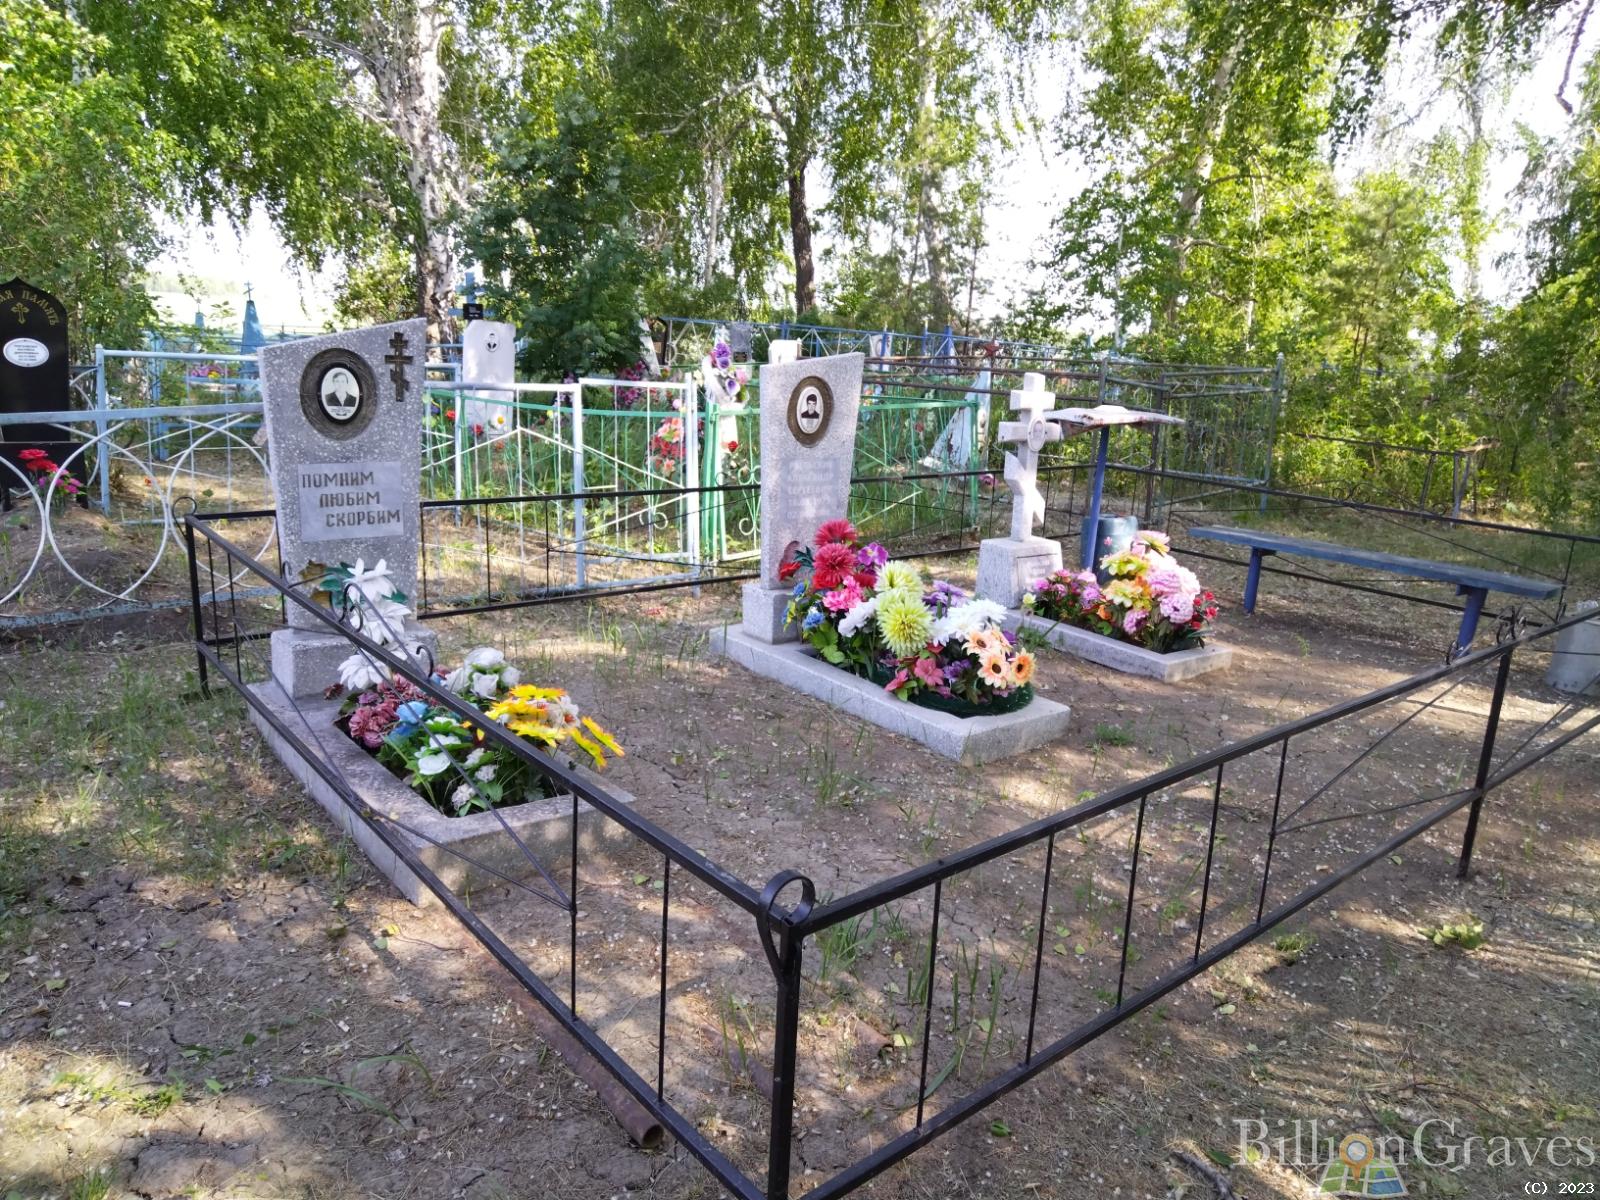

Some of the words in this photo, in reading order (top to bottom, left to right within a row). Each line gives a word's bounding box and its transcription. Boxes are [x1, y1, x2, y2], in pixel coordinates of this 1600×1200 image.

[302, 471, 374, 488] ПОМНИМ
[319, 491, 380, 508] ЛЮБИМ
[326, 509, 400, 528] СКОРБИМ
